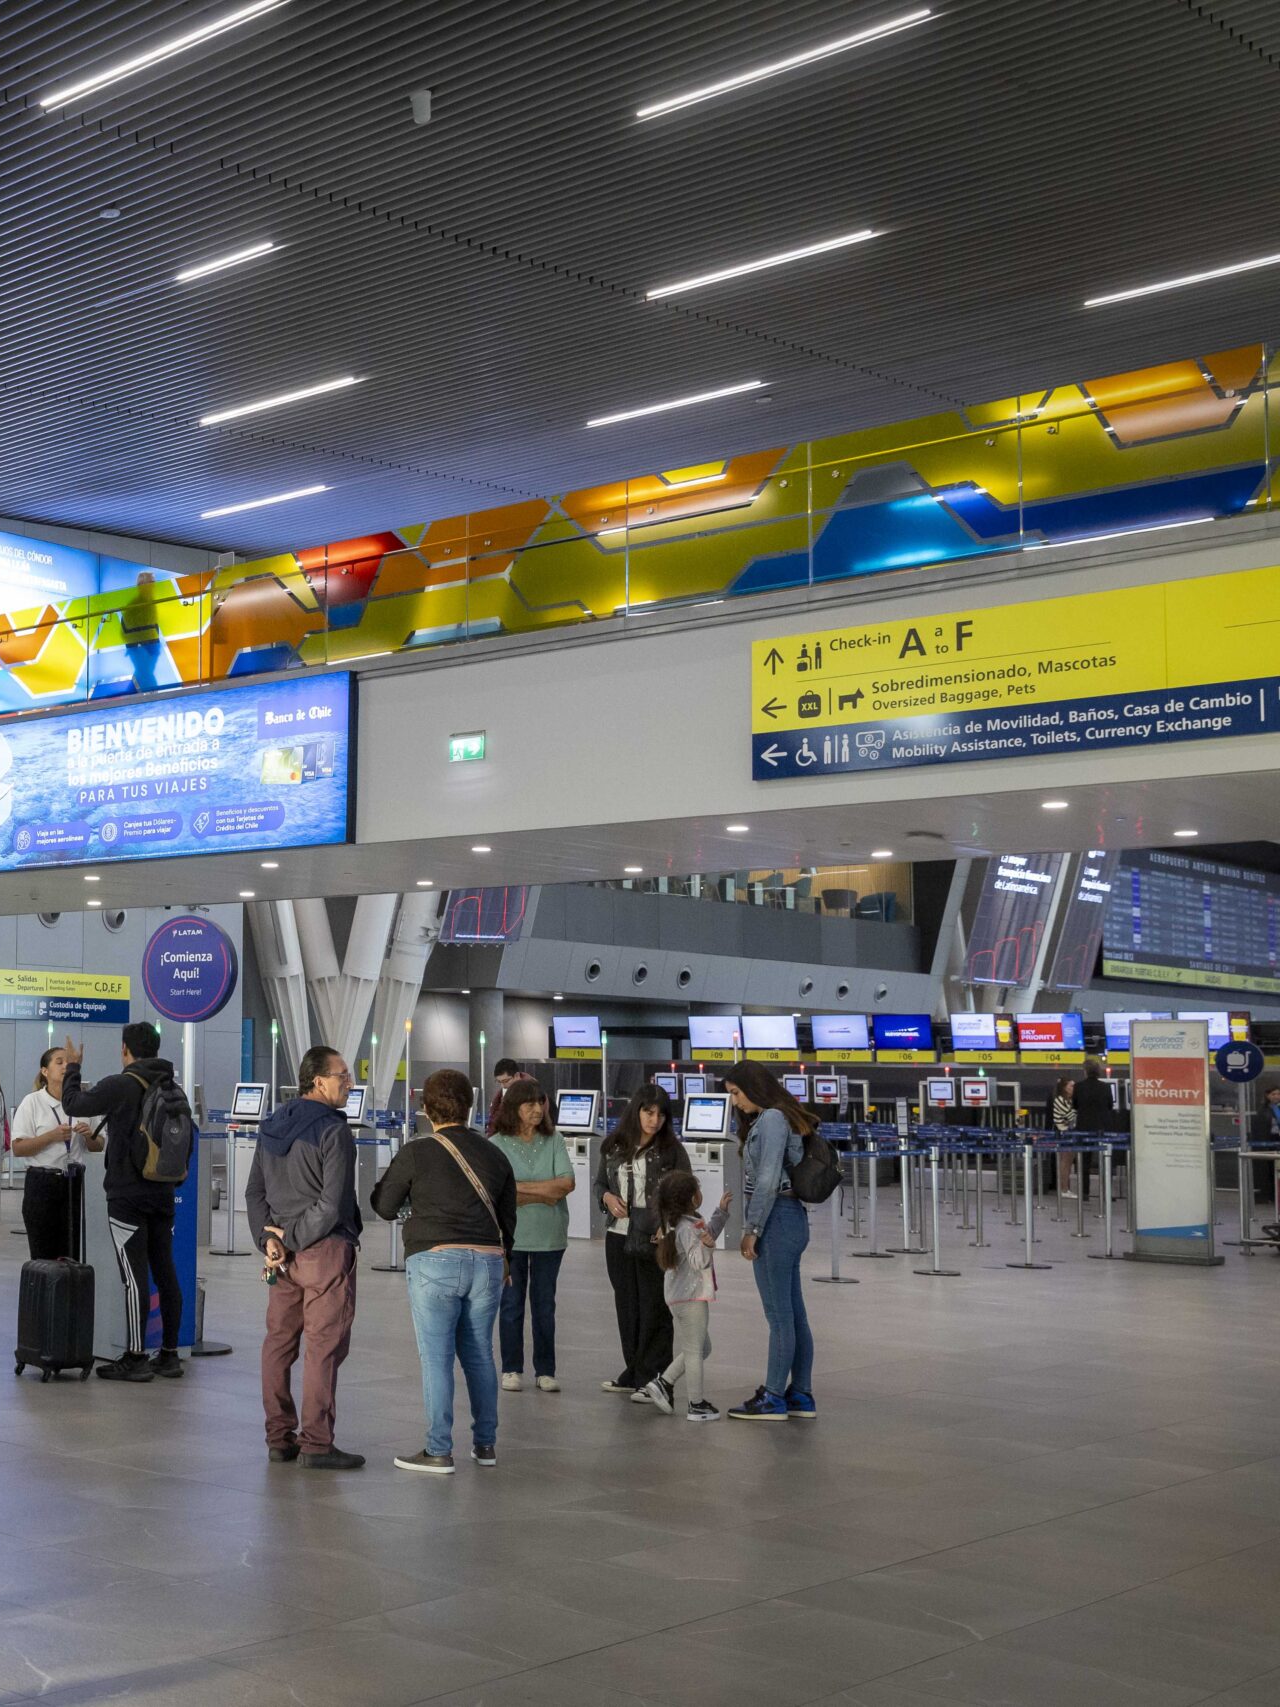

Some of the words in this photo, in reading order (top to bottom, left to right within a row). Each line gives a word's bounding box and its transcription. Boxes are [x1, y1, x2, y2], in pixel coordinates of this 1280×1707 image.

[14, 547, 26, 559] DEL
[27, 550, 53, 565] CÓNDOR
[829, 632, 891, 652] Check-in
[898, 628, 927, 659] A
[934, 626, 943, 637] a
[955, 620, 973, 651] F
[935, 643, 949, 654] to
[872, 664, 1032, 694] Sobredimensionado,
[1037, 655, 1117, 675] Mascotas
[872, 693, 936, 711] Oversized
[940, 686, 1003, 705] Baggage,
[1007, 682, 1036, 696] Pets
[801, 701, 819, 712] XXL
[264, 711, 294, 725] Banco
[296, 709, 306, 721] de
[308, 706, 332, 719] Chile
[892, 722, 961, 742] Asistencia
[964, 718, 983, 734] de
[986, 710, 1064, 731] Movilidad,
[1068, 707, 1119, 723] Baños,
[1123, 703, 1160, 718] Casa
[1164, 699, 1185, 714] de
[1189, 691, 1252, 710] Cambio
[67, 707, 225, 753] BIENVENIDO
[891, 742, 947, 759] Mobility
[950, 735, 1027, 754] Assistance,
[1030, 730, 1081, 745] Toilets,
[1085, 723, 1152, 741] Currency
[1156, 715, 1232, 733] Exchange
[91, 750, 133, 769] puerta
[135, 744, 153, 759] de
[156, 737, 208, 757] entrada
[212, 738, 220, 750] a
[67, 772, 87, 787] los
[89, 766, 142, 786] mejores
[145, 756, 219, 777] Beneficios
[80, 788, 115, 804] PARA
[122, 784, 148, 799] TUS
[155, 777, 208, 795] VIAJES
[1149, 853, 1190, 869] AEROPUERTO
[160, 950, 213, 966] ¡Comienza
[17, 974, 38, 983] Salidas
[173, 967, 200, 982] Aquí!
[17, 983, 45, 992] Departures
[170, 988, 185, 996] Start
[186, 988, 202, 996] Here!
[49, 1001, 74, 1009] Custodia
[82, 1002, 107, 1012] Equipaje
[49, 1010, 70, 1018] Baggage
[70, 1011, 90, 1019] Storage
[1139, 1042, 1184, 1051] Argentinas
[1136, 1079, 1164, 1089] SKY
[1136, 1089, 1201, 1099] PRIORITY
